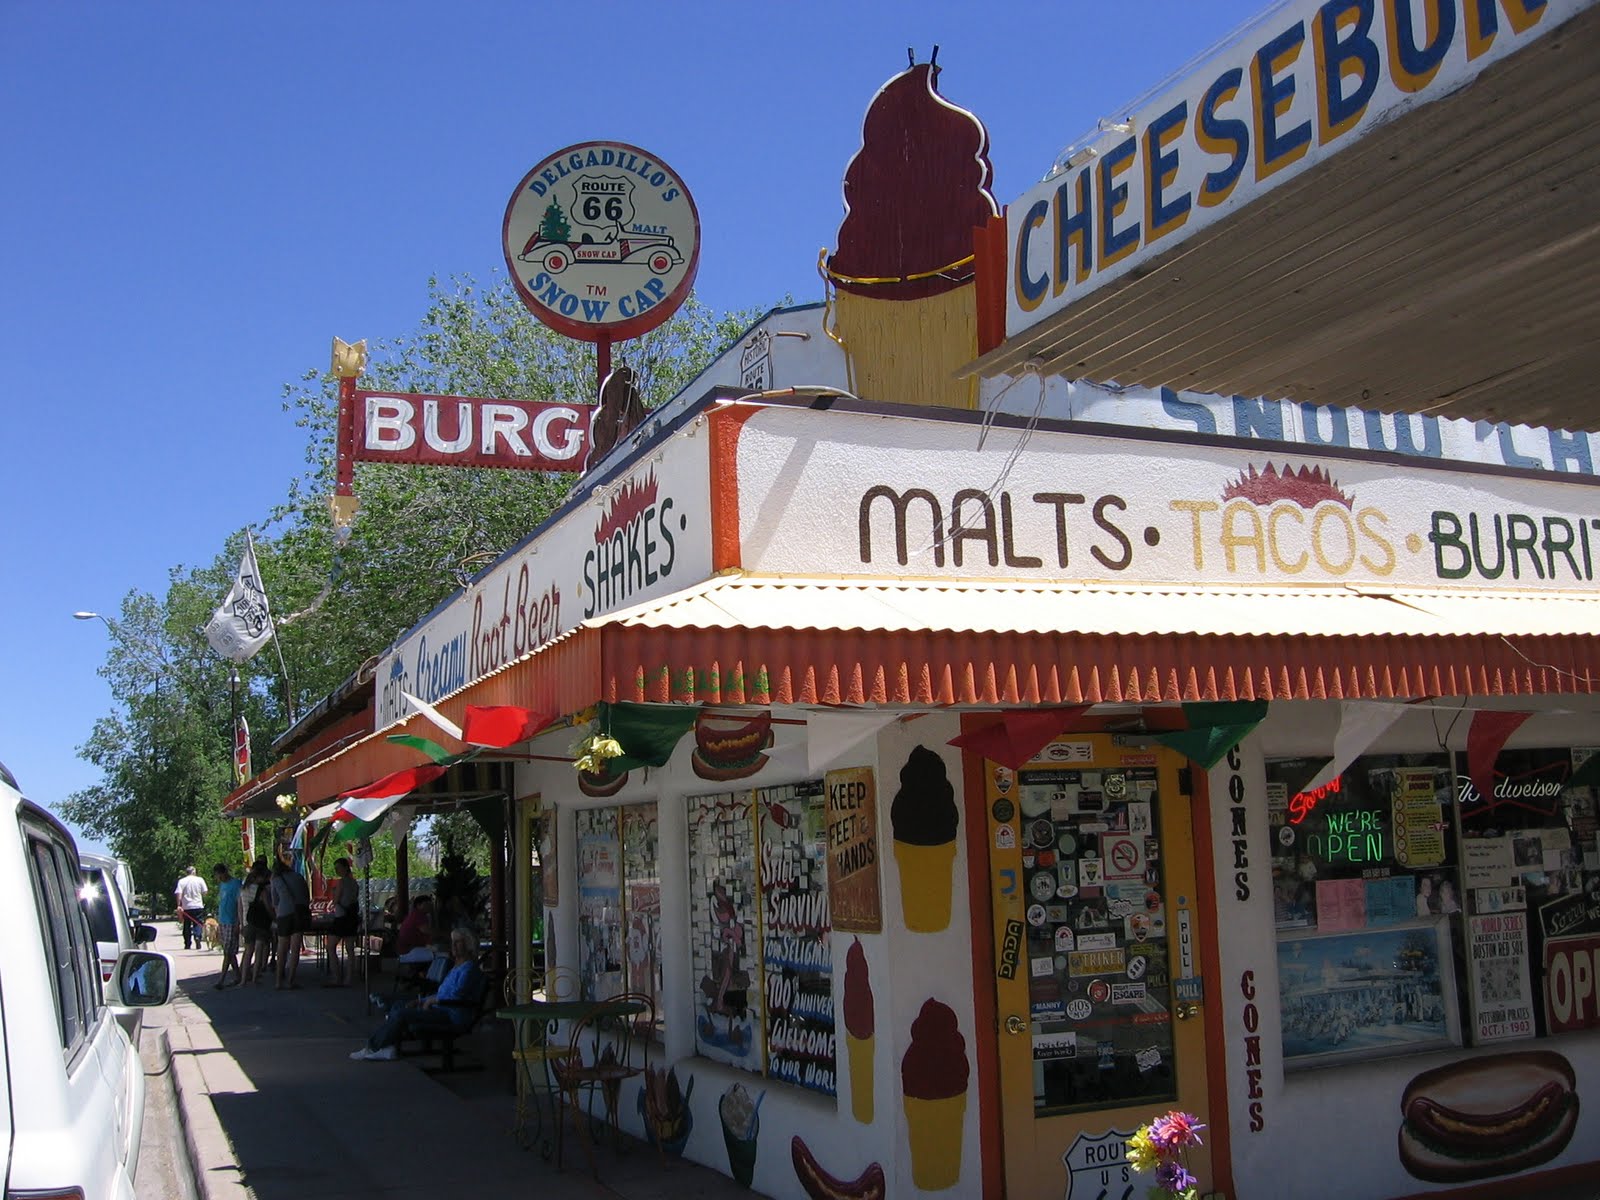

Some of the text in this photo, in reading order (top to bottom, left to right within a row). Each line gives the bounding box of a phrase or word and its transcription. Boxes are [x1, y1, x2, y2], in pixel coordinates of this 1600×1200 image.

[528, 149, 680, 202] DELGADILLO'S
[581, 182, 626, 192] ROUTE
[582, 196, 623, 221] 66
[632, 223, 667, 235] MALT
[577, 250, 617, 259] SNOW CAP
[527, 272, 667, 322] SNOW CAP
[586, 284, 607, 296] TM
[859, 485, 1133, 571] MALTS
[1170, 498, 1397, 577] TACOS
[468, 573, 510, 683] Root
[583, 497, 675, 620] SHAKES
[829, 781, 866, 811] KEEP
[1456, 775, 1564, 803] dweiser
[828, 813, 857, 850] FEET
[1325, 809, 1382, 836] WE'RE
[836, 838, 876, 878] HANDS
[1307, 832, 1383, 863] OPEN
[1181, 922, 1189, 968] PULL
[1175, 983, 1200, 998] PULL
[771, 1017, 836, 1058] WELCOME
[1240, 970, 1264, 1134] CONES
